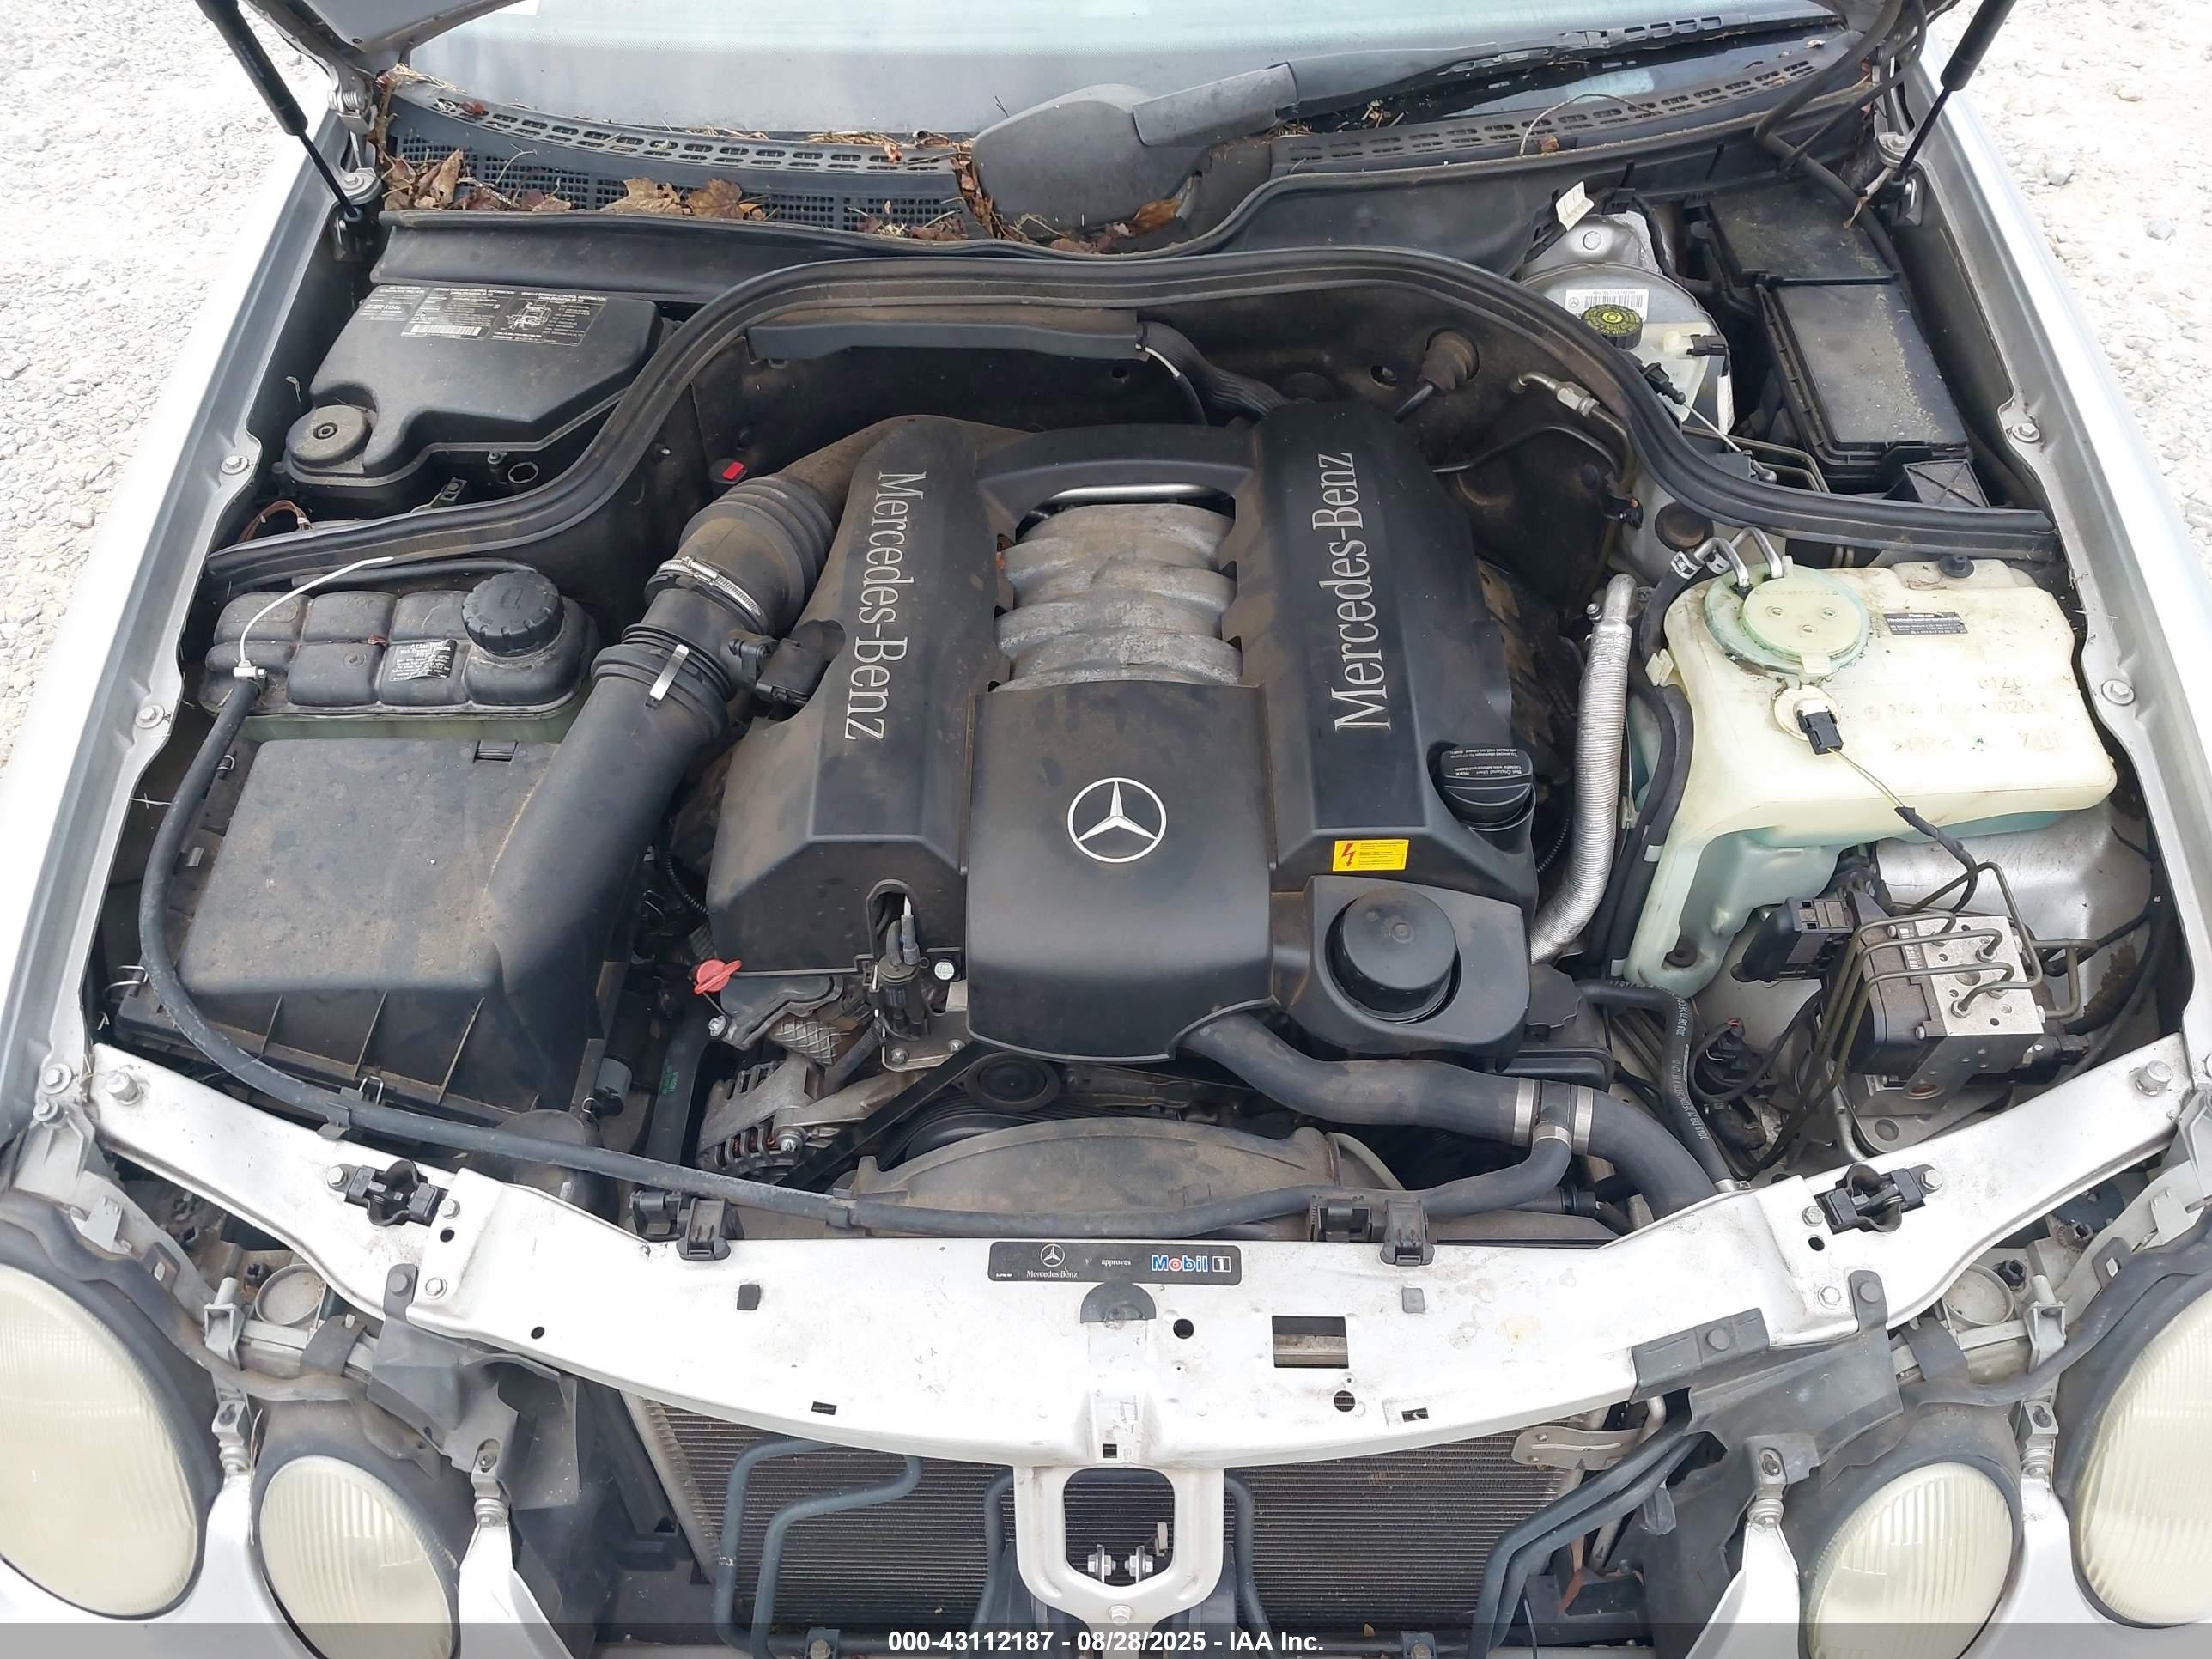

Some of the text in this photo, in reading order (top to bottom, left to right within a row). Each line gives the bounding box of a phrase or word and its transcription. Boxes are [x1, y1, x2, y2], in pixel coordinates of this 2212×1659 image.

[844, 471, 927, 740] Mercedes-Benz
[1310, 452, 1392, 732] Mercedes-Benz
[1026, 1270, 1079, 1279] Mercedes-Benz
[1151, 1255, 1208, 1273] Mobil
